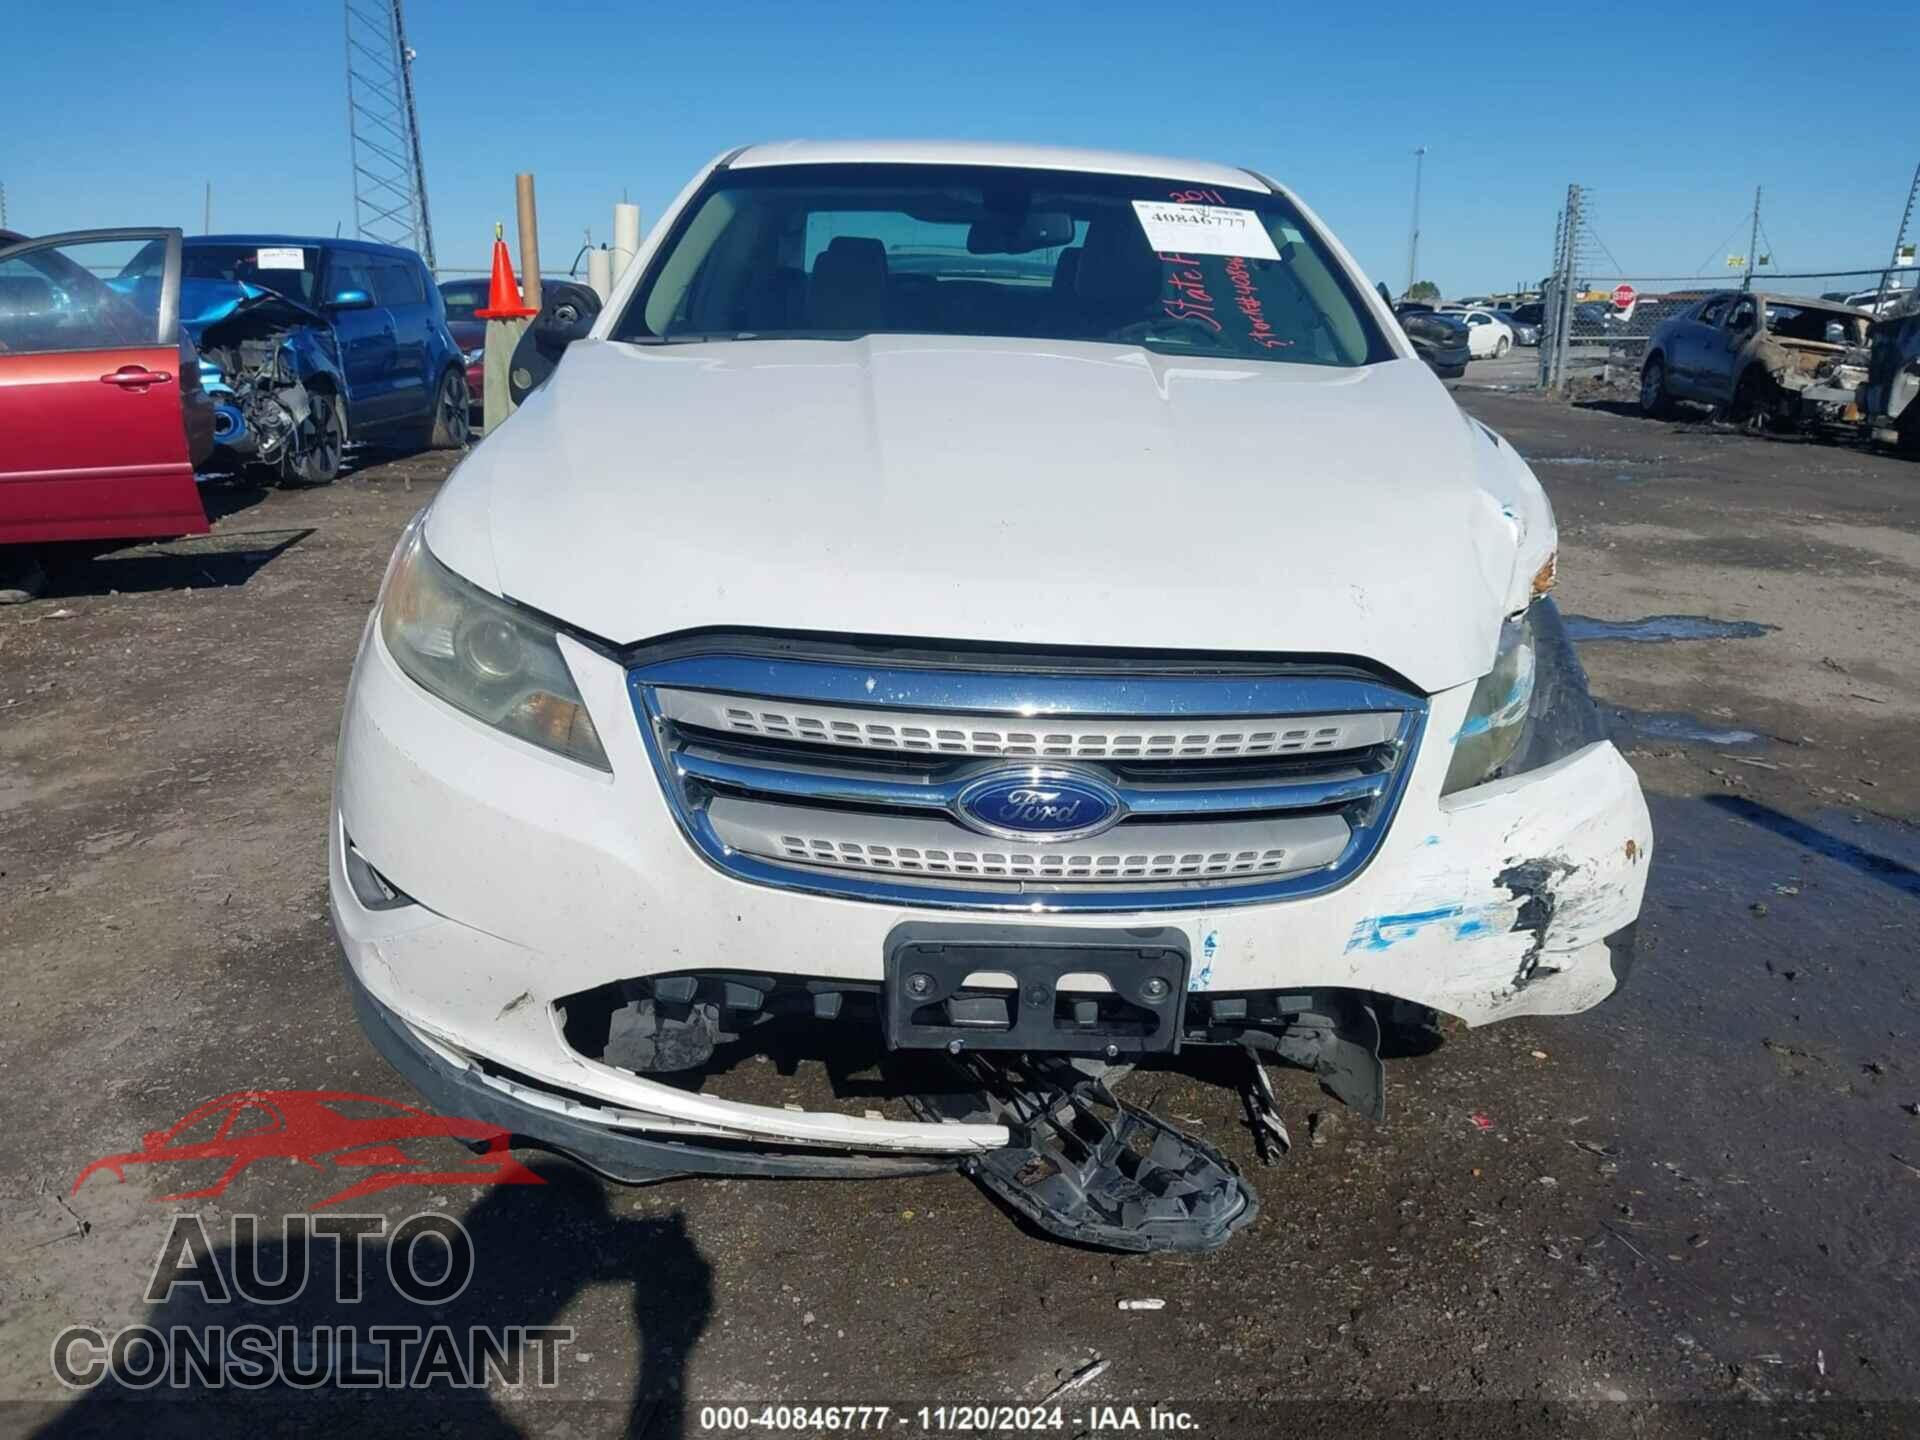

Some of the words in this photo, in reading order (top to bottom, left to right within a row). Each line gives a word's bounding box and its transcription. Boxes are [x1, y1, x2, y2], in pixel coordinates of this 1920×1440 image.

[1151, 212, 1246, 229] 40846777
[1162, 269, 1222, 332] State
[1614, 291, 1635, 300] STOP
[1000, 789, 1081, 822] Ford
